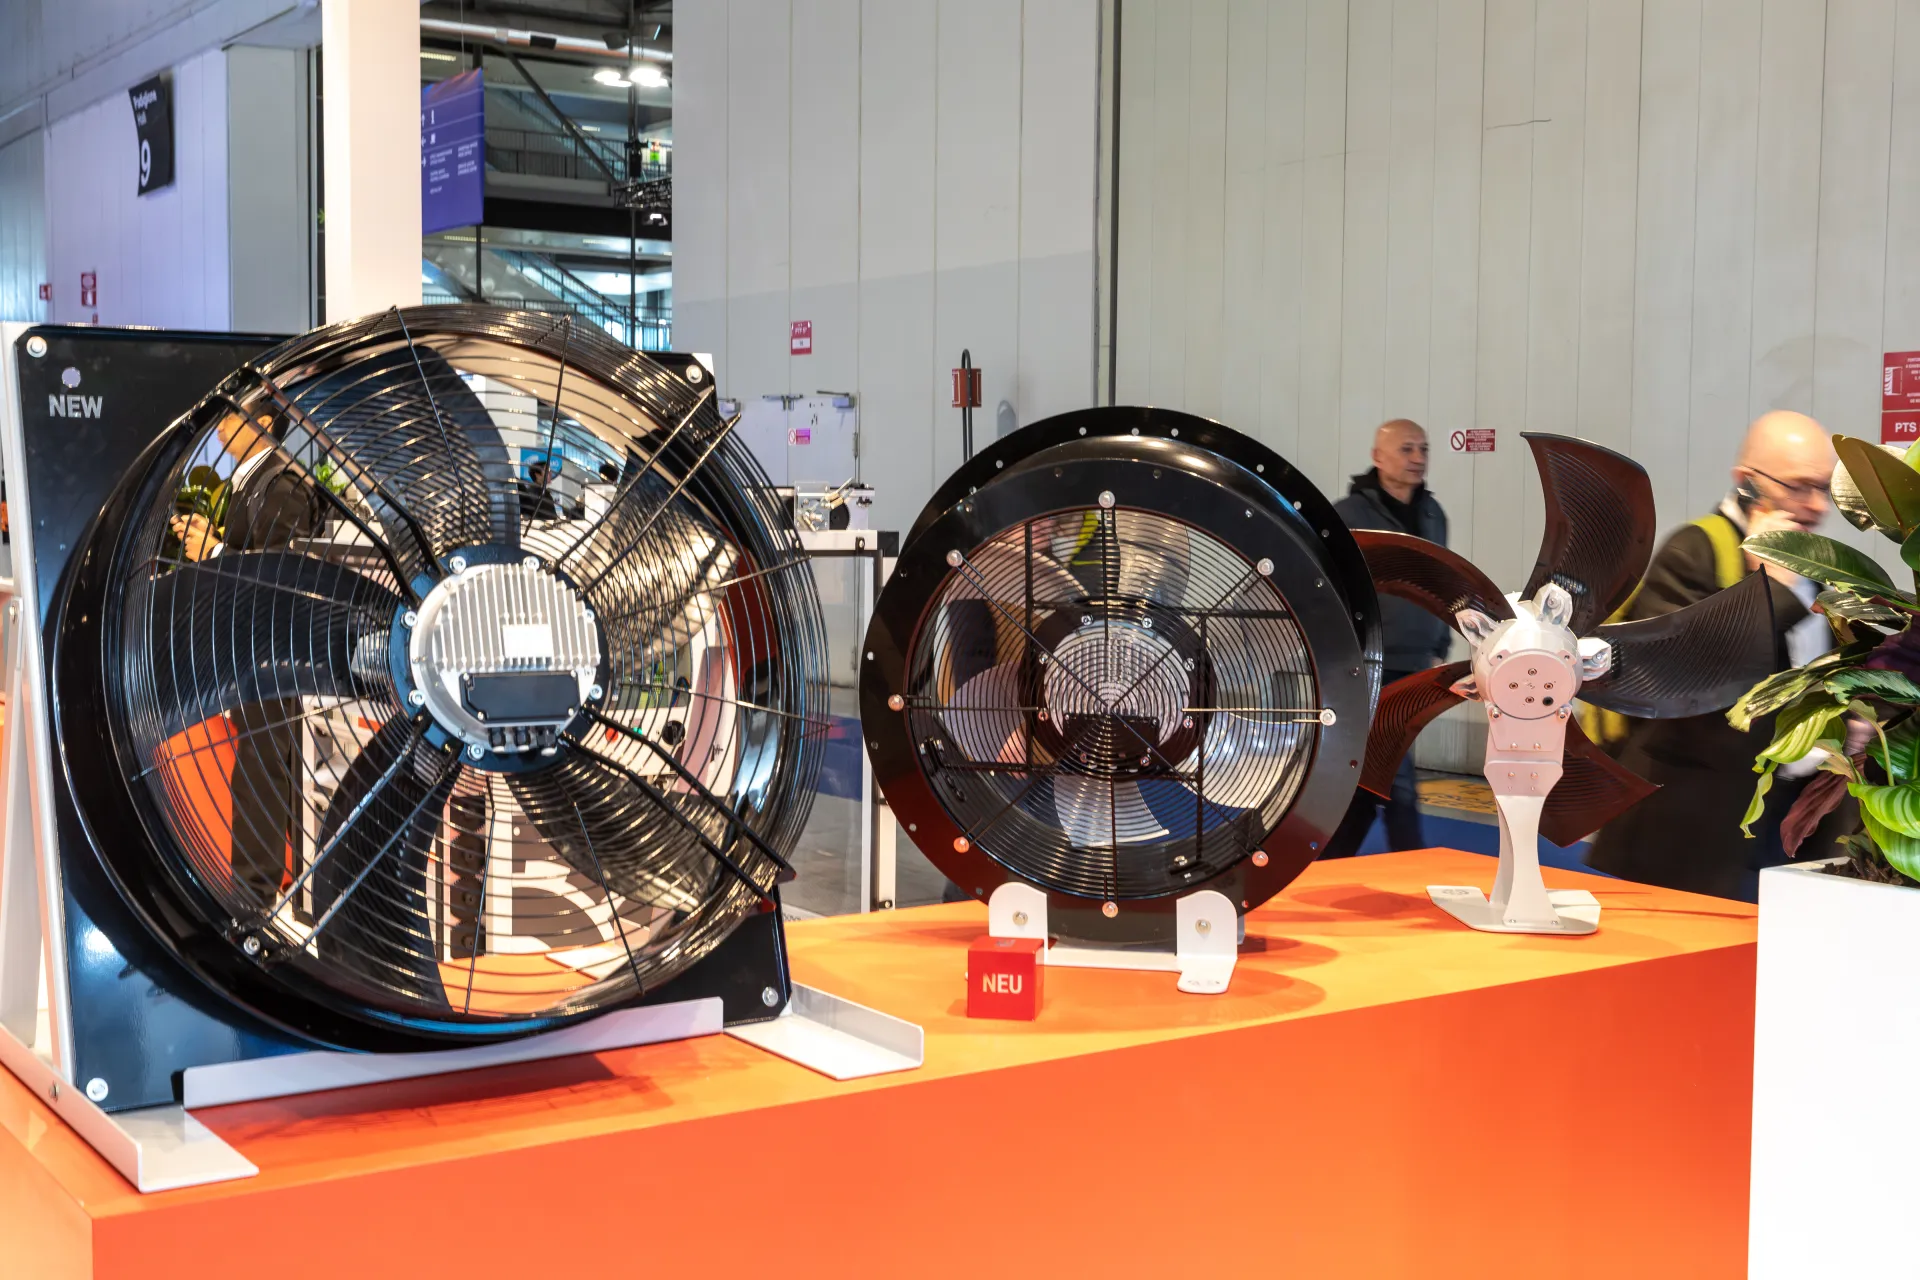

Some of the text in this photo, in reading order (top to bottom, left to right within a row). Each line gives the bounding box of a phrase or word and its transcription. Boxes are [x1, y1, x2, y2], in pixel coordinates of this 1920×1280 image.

[141, 139, 151, 187] 9
[48, 394, 103, 418] NEW
[1895, 422, 1917, 433] PTS
[982, 973, 1022, 994] NEU
